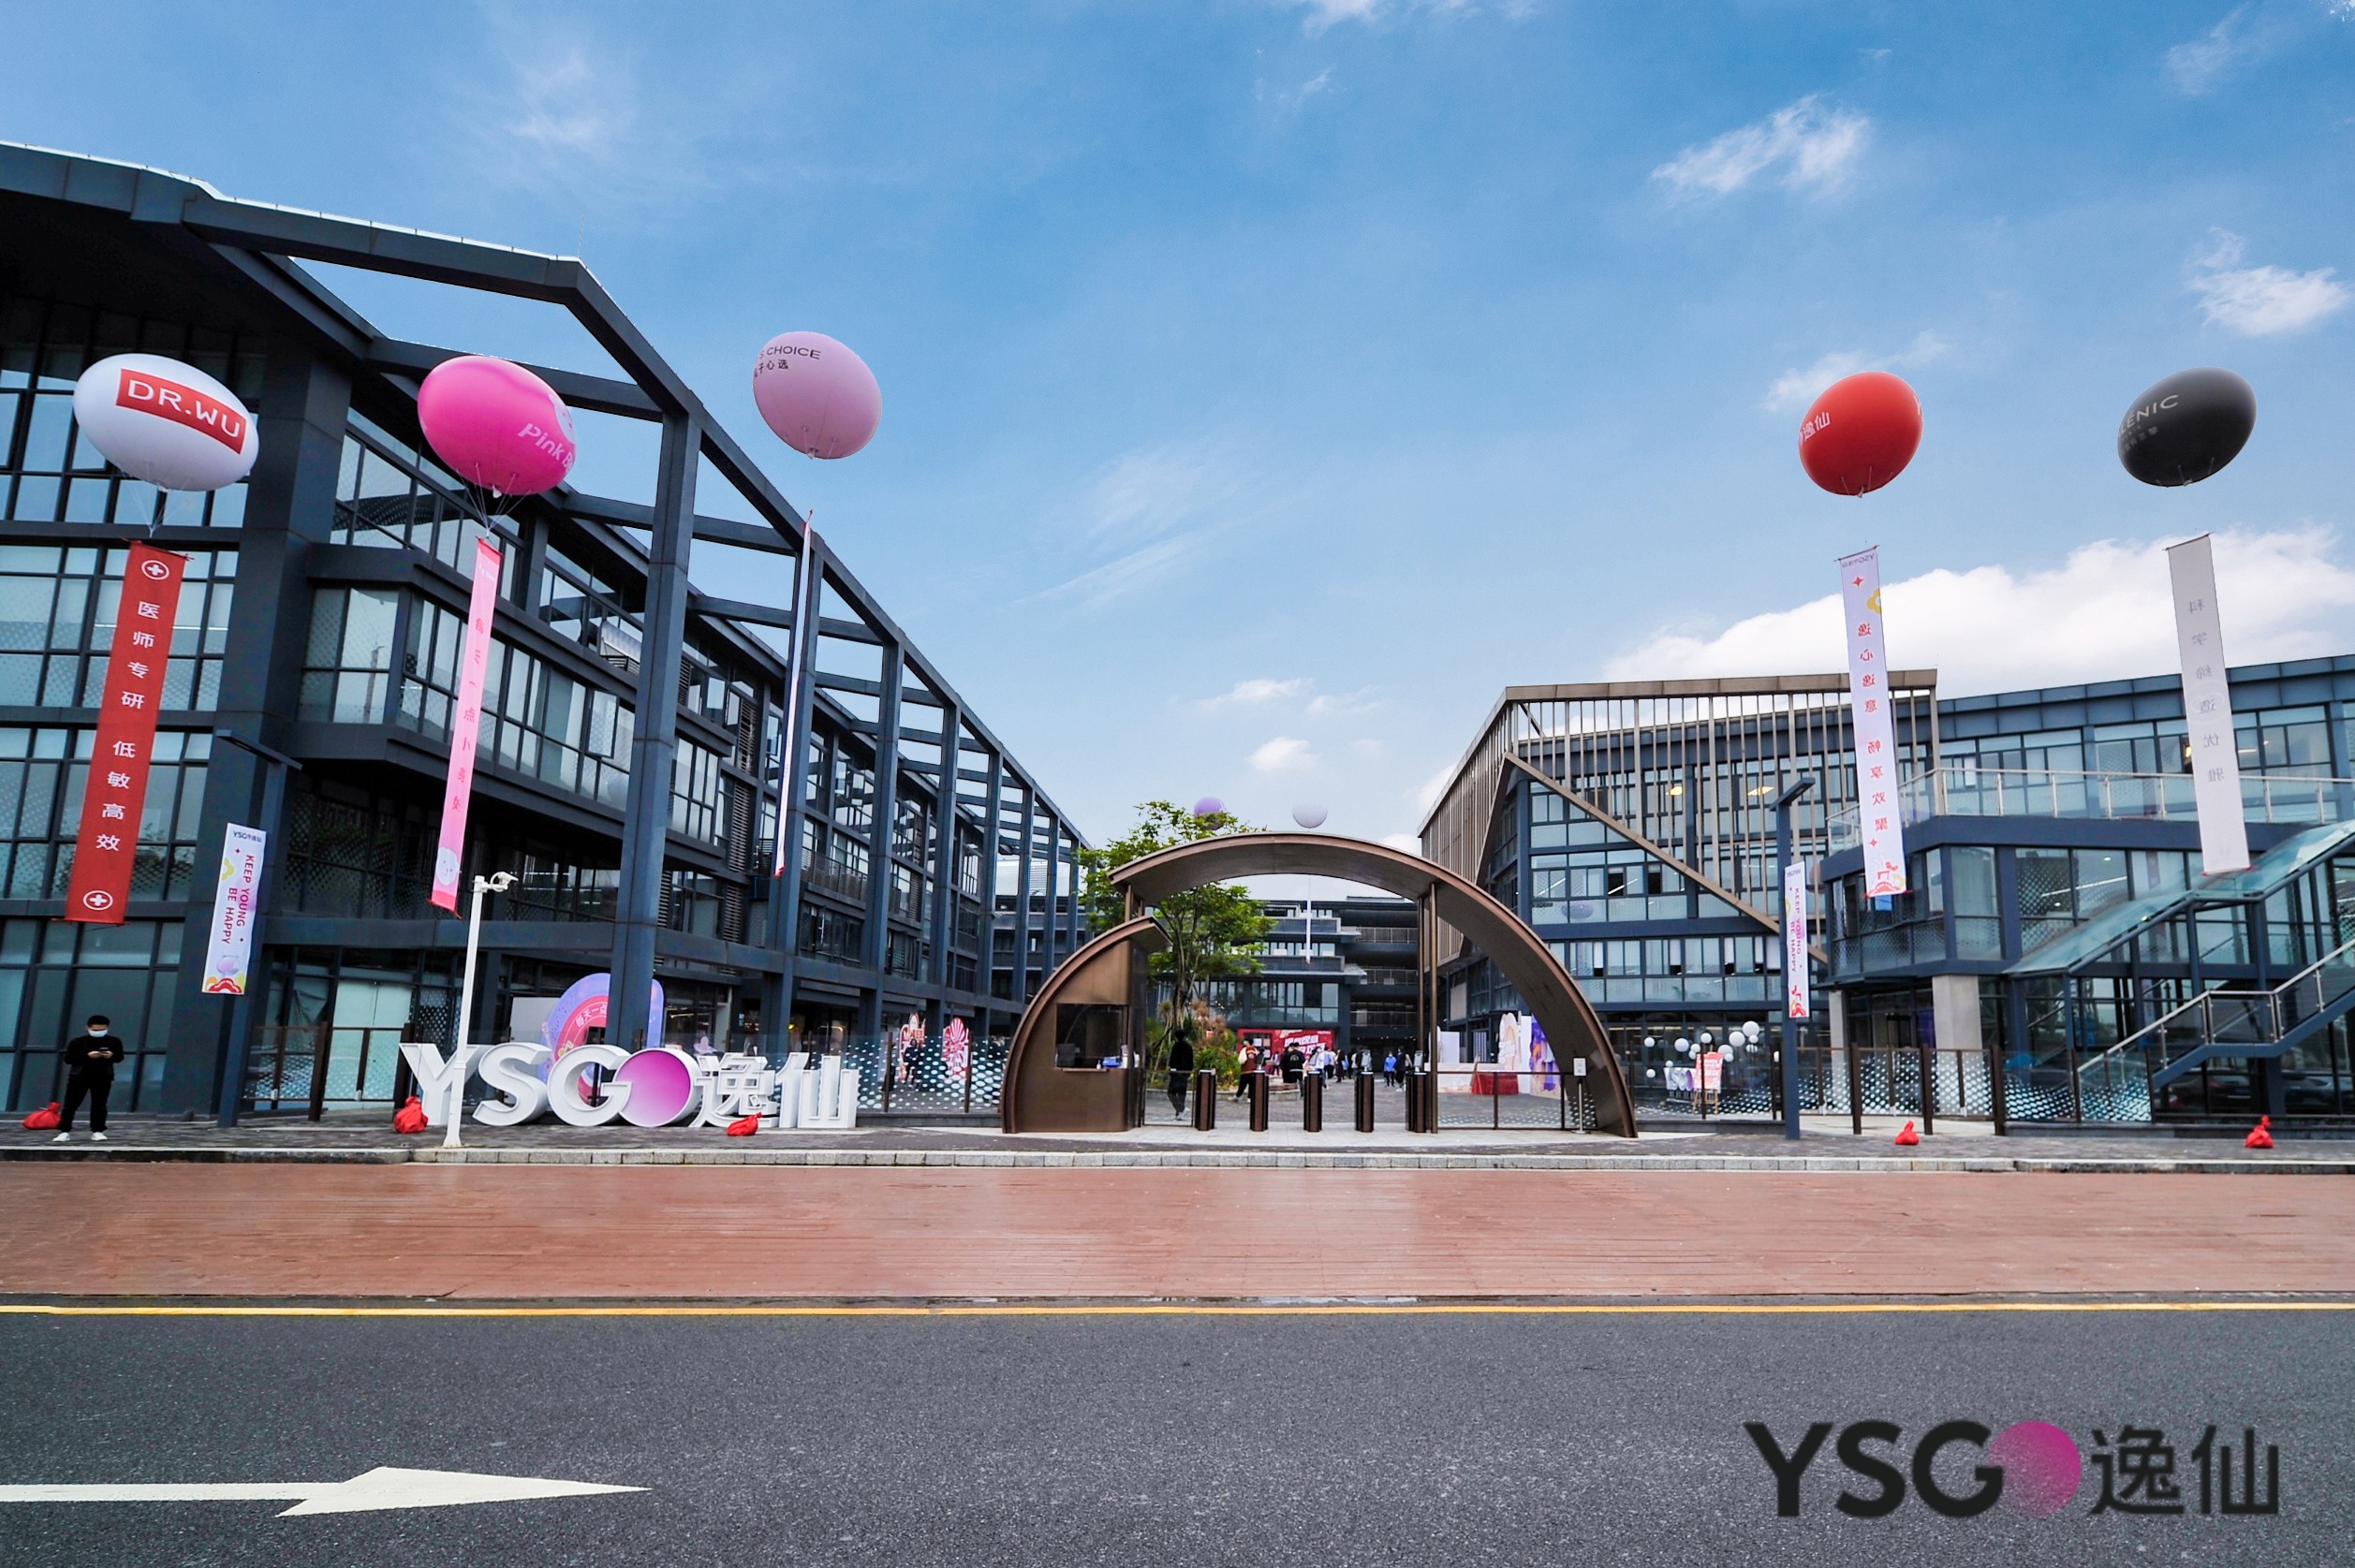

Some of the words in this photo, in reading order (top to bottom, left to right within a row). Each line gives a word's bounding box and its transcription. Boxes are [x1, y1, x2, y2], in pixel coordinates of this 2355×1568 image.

[766, 345, 821, 359] CHOICE
[127, 379, 241, 438] DR.WU
[1803, 411, 1832, 443] 逸仙
[517, 422, 565, 462] Pink
[120, 601, 161, 711] 医师专研
[96, 740, 137, 852] 低敏高效
[243, 854, 255, 884] KEEP
[227, 887, 238, 901] BE
[236, 887, 250, 927] YOUNG
[221, 906, 235, 945] HAPPY
